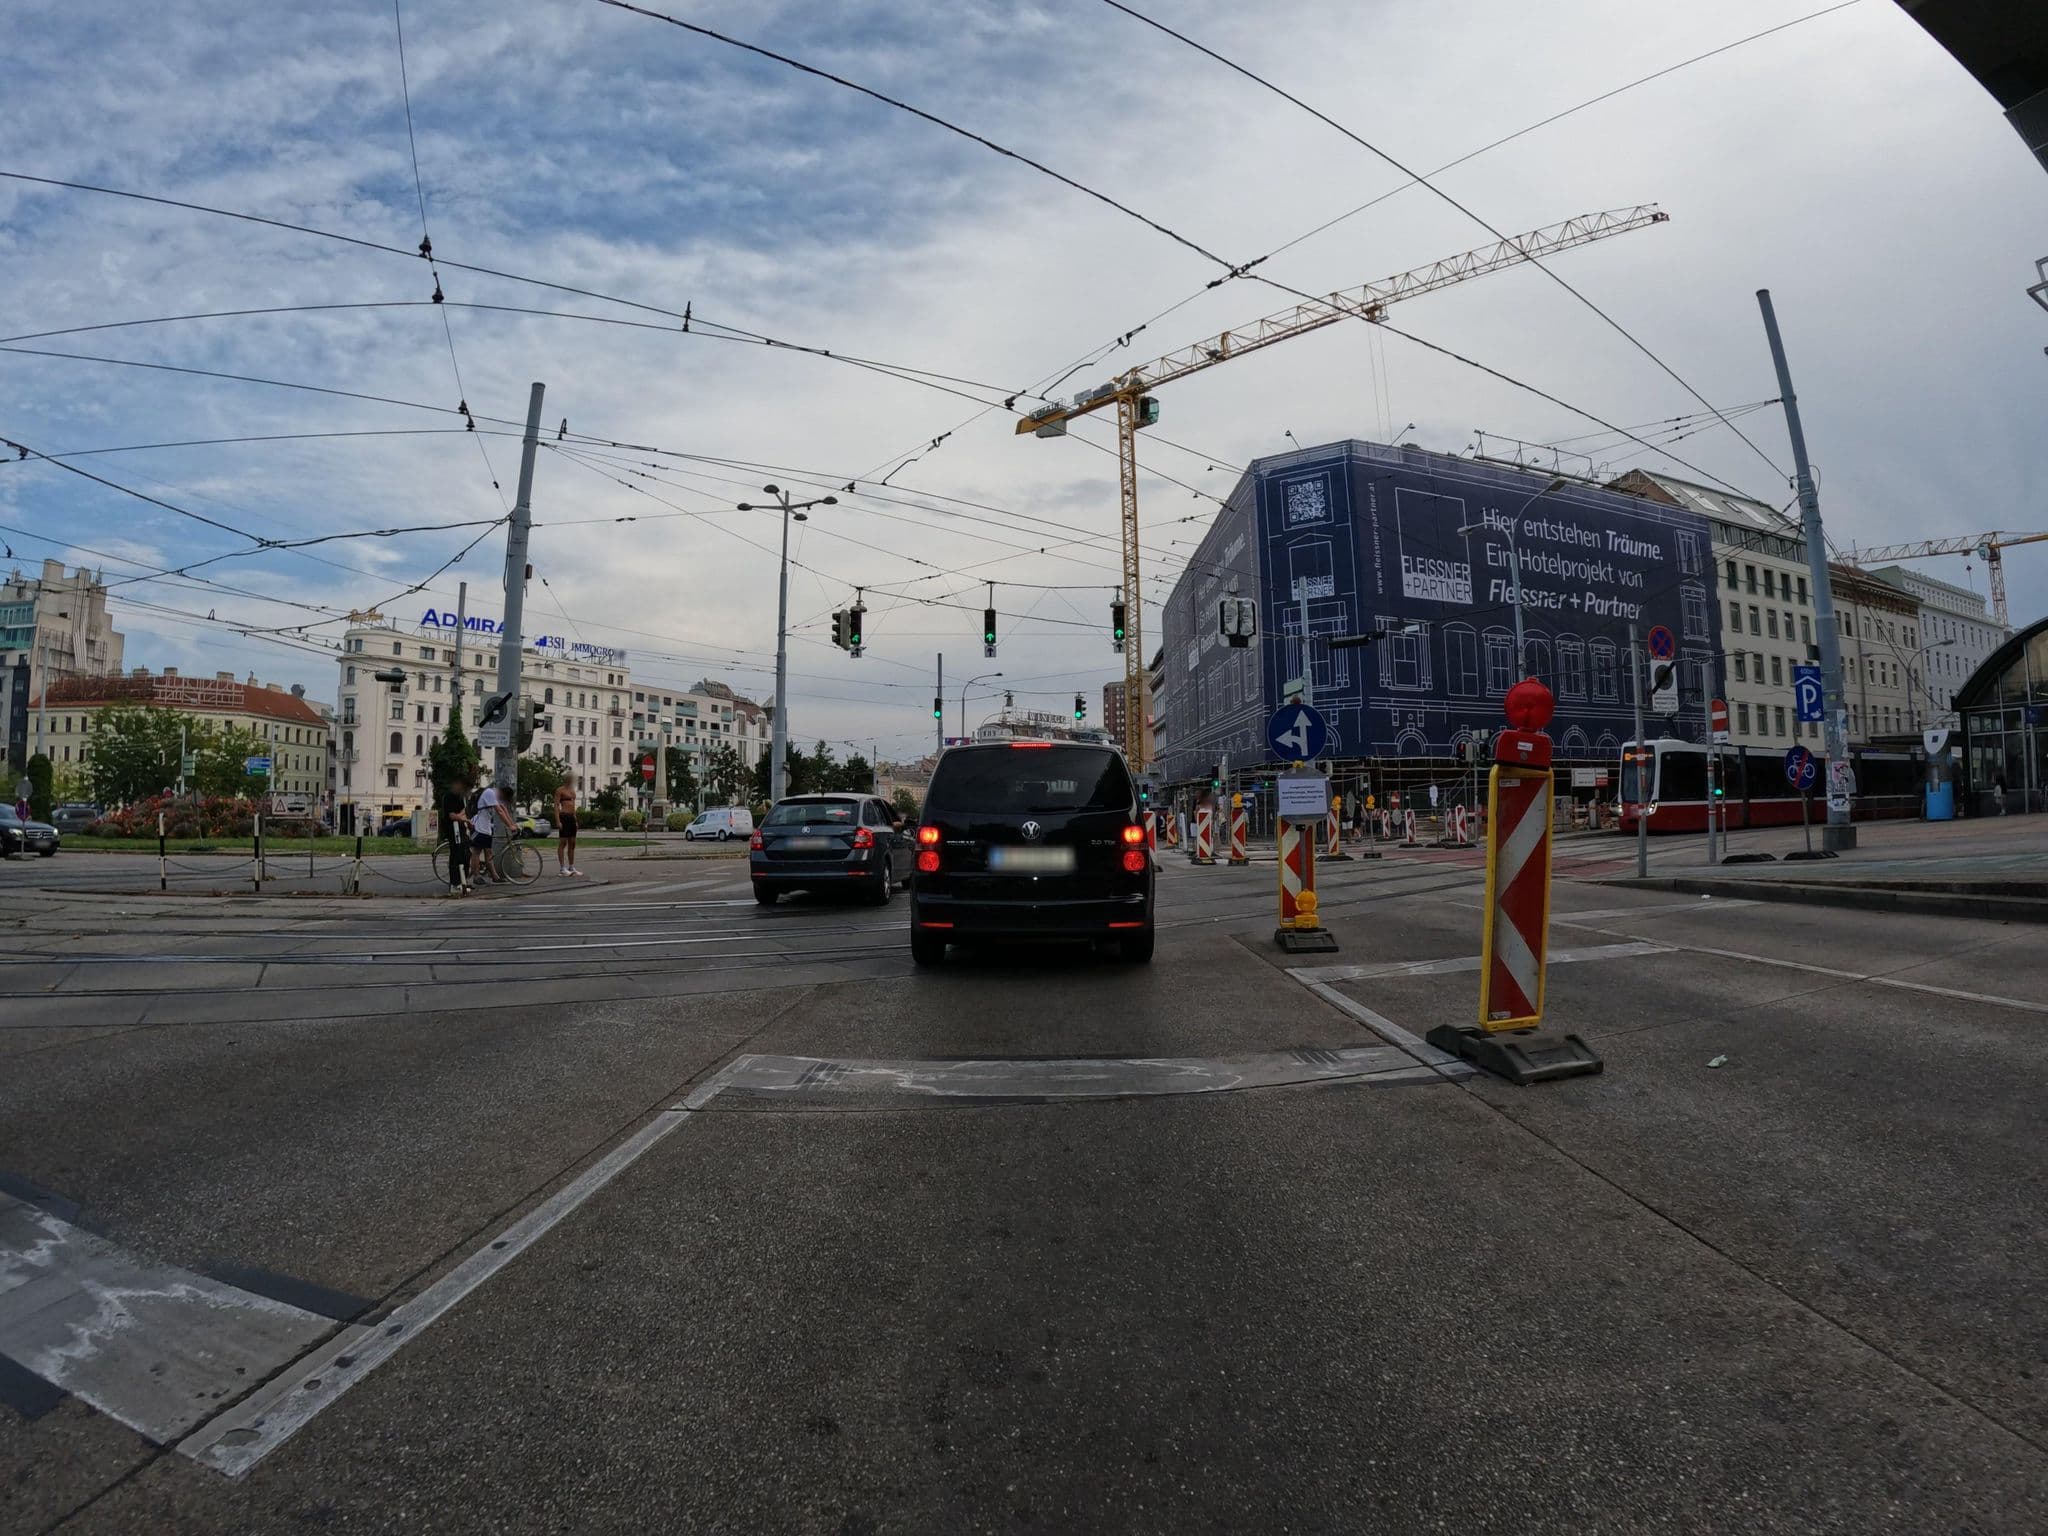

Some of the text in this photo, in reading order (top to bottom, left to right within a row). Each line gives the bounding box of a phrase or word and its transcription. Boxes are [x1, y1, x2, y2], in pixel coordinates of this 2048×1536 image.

[1523, 518, 1601, 549] entstehen
[1606, 530, 1664, 560] Träume.
[1401, 555, 1470, 582] FLEISSNER
[1518, 547, 1615, 585] Hotelprojekt
[1617, 570, 1644, 589] von
[1489, 579, 1568, 610] Flessner
[1585, 592, 1644, 620] Partner
[420, 608, 505, 634] ADMIRA
[571, 642, 628, 660] IMMOGRO
[1802, 684, 1817, 713] P
